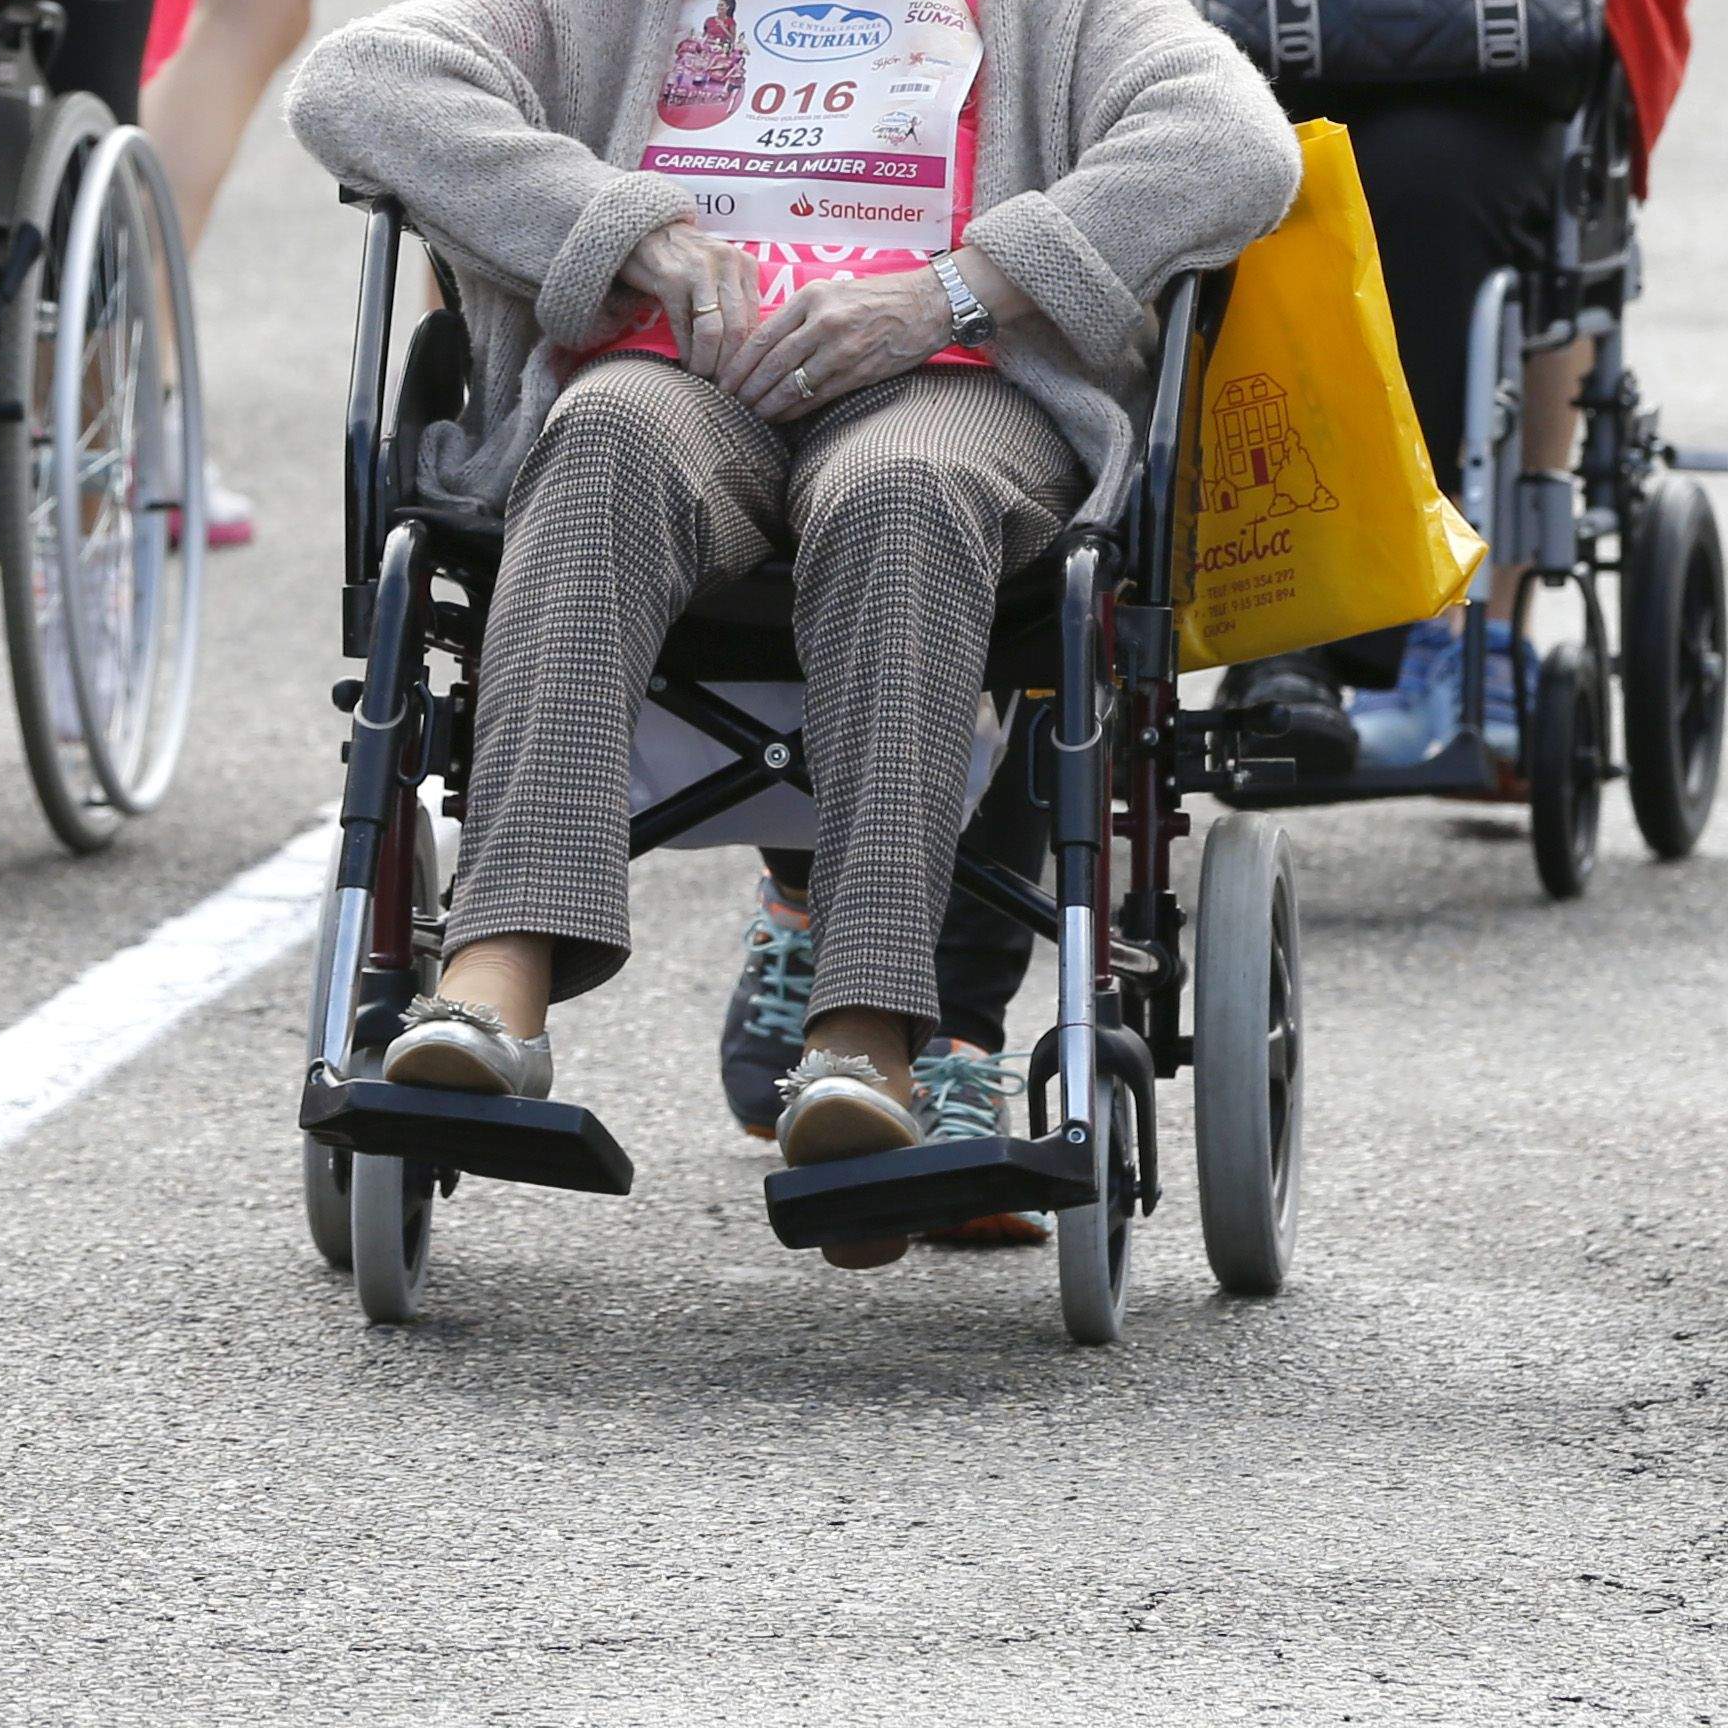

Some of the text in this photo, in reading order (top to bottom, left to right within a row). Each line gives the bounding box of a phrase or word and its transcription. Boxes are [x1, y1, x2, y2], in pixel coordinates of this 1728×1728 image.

[908, 1, 922, 10] TU
[904, 9, 965, 31] SUMA
[764, 19, 881, 49] ASTURIANA
[750, 80, 858, 115] 016
[757, 127, 824, 149] 4523
[654, 153, 918, 178] CARRERA DE LA MUJER 2023
[818, 198, 925, 223] Santander
